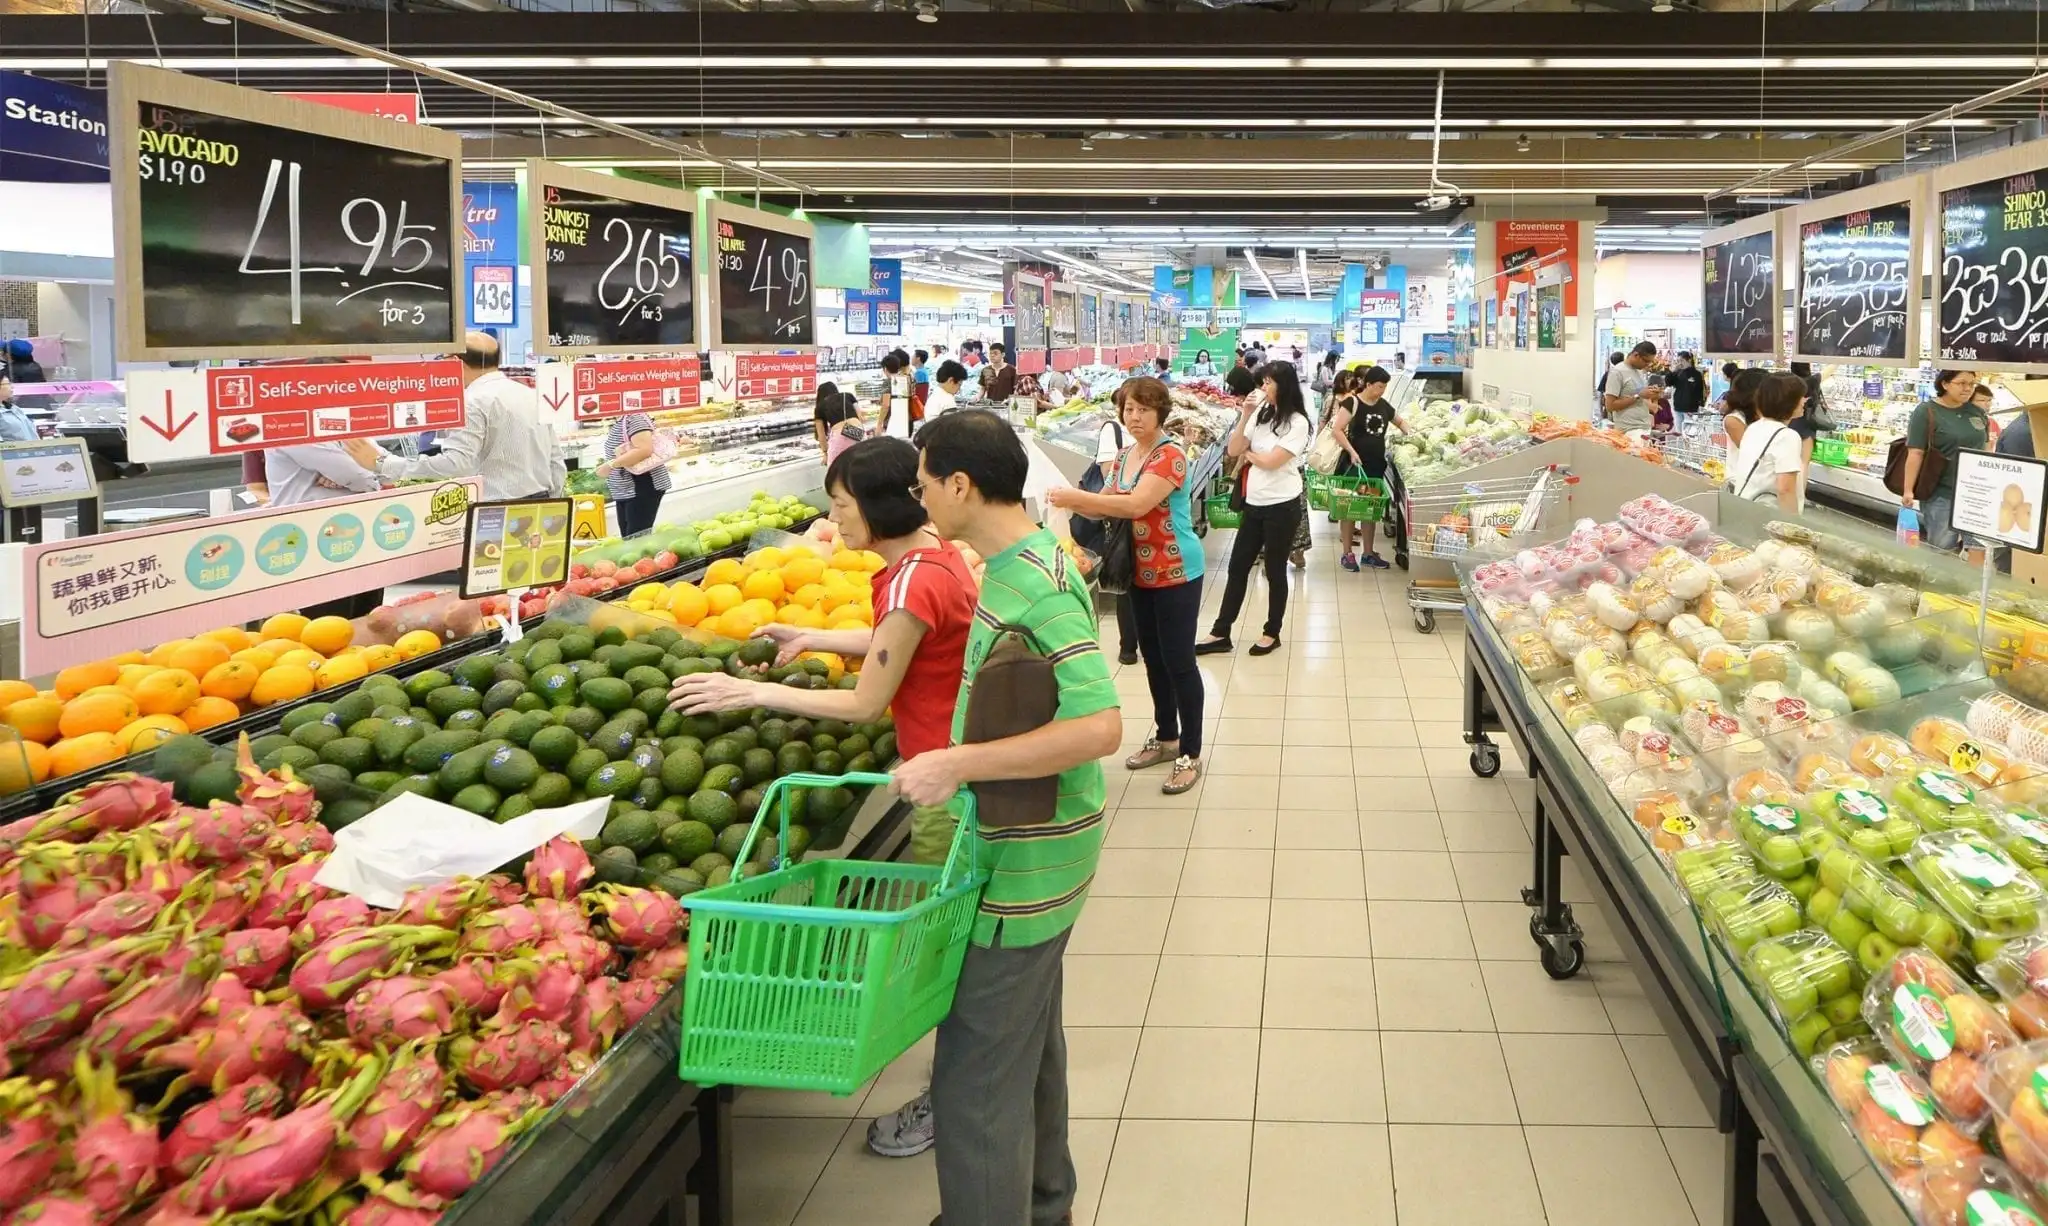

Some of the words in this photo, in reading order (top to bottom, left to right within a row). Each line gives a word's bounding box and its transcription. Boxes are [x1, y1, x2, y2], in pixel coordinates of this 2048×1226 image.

[6, 97, 106, 137] Station
[138, 129, 239, 167] AVOCADO
[138, 154, 206, 186] $1.90
[2003, 174, 2037, 196] CHINA
[543, 206, 591, 229] SUNKIST
[1509, 221, 1566, 231] Convenience
[2003, 210, 2034, 231] PEAR
[238, 159, 437, 325] 4.95
[543, 224, 588, 247] ORANGE
[379, 298, 408, 326] for
[411, 305, 425, 325] 3
[641, 305, 654, 320] for
[655, 306, 663, 322] 3
[259, 380, 357, 399] Self-Service
[358, 375, 428, 394] Weighing
[429, 373, 461, 388] Item
[596, 371, 646, 384] Self-Service
[645, 367, 681, 382] Weighing
[681, 367, 698, 379] Item
[1977, 460, 2001, 471] ASIAN
[2001, 463, 2023, 474] PEAR
